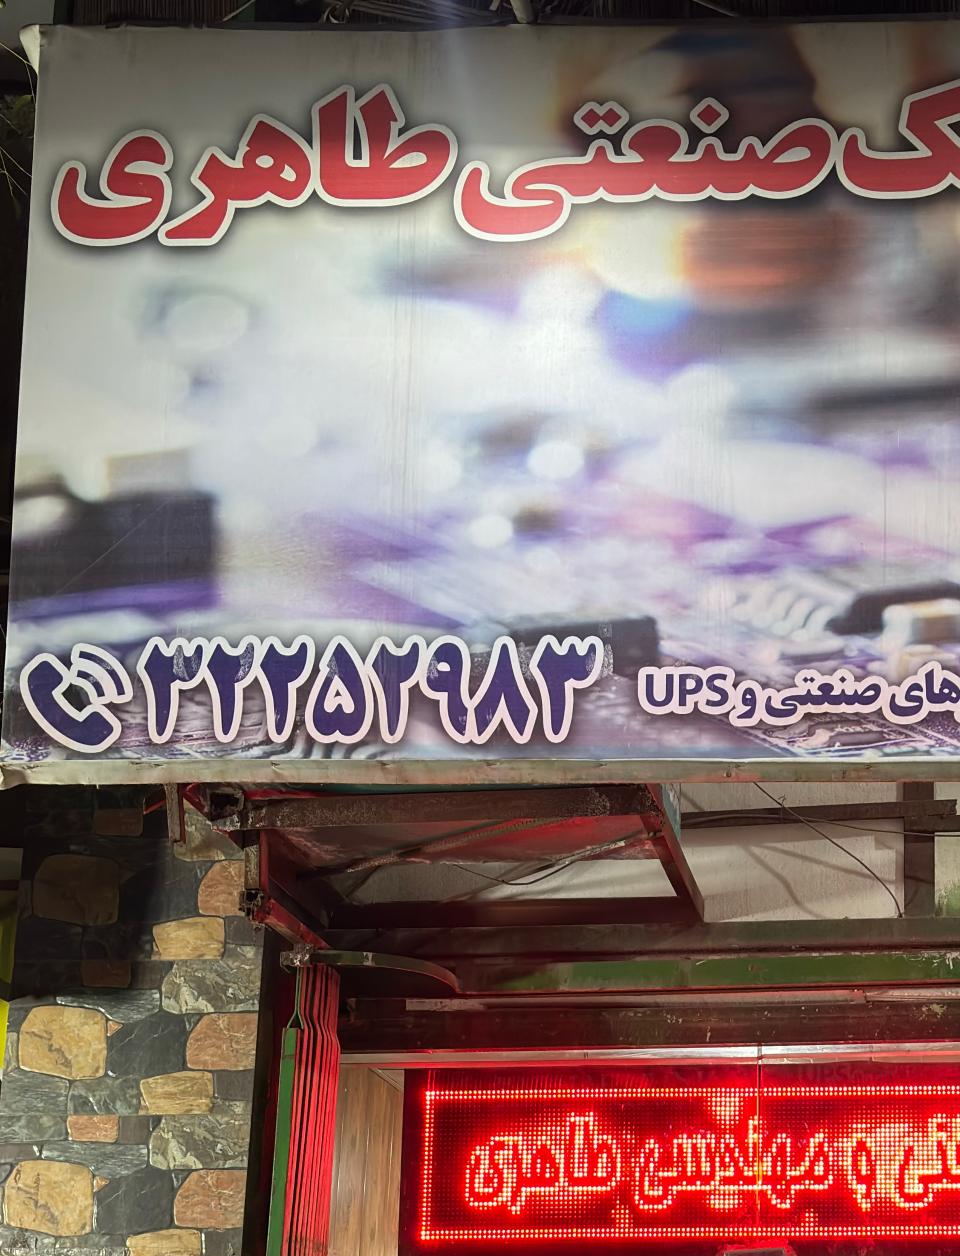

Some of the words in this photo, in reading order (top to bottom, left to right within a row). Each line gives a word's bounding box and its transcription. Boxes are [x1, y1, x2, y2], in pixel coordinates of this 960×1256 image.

[56, 86, 454, 243] طاهری
[458, 99, 833, 241] صنعتی
[141, 639, 601, 741] ۳۲۲۵۲۹۸۳
[645, 673, 730, 707] UPS
[738, 687, 758, 719] و
[765, 671, 882, 719] صنعتی
[465, 1111, 621, 1216] طاهری
[634, 1115, 834, 1211] مهندسی
[848, 1130, 877, 1212] و
